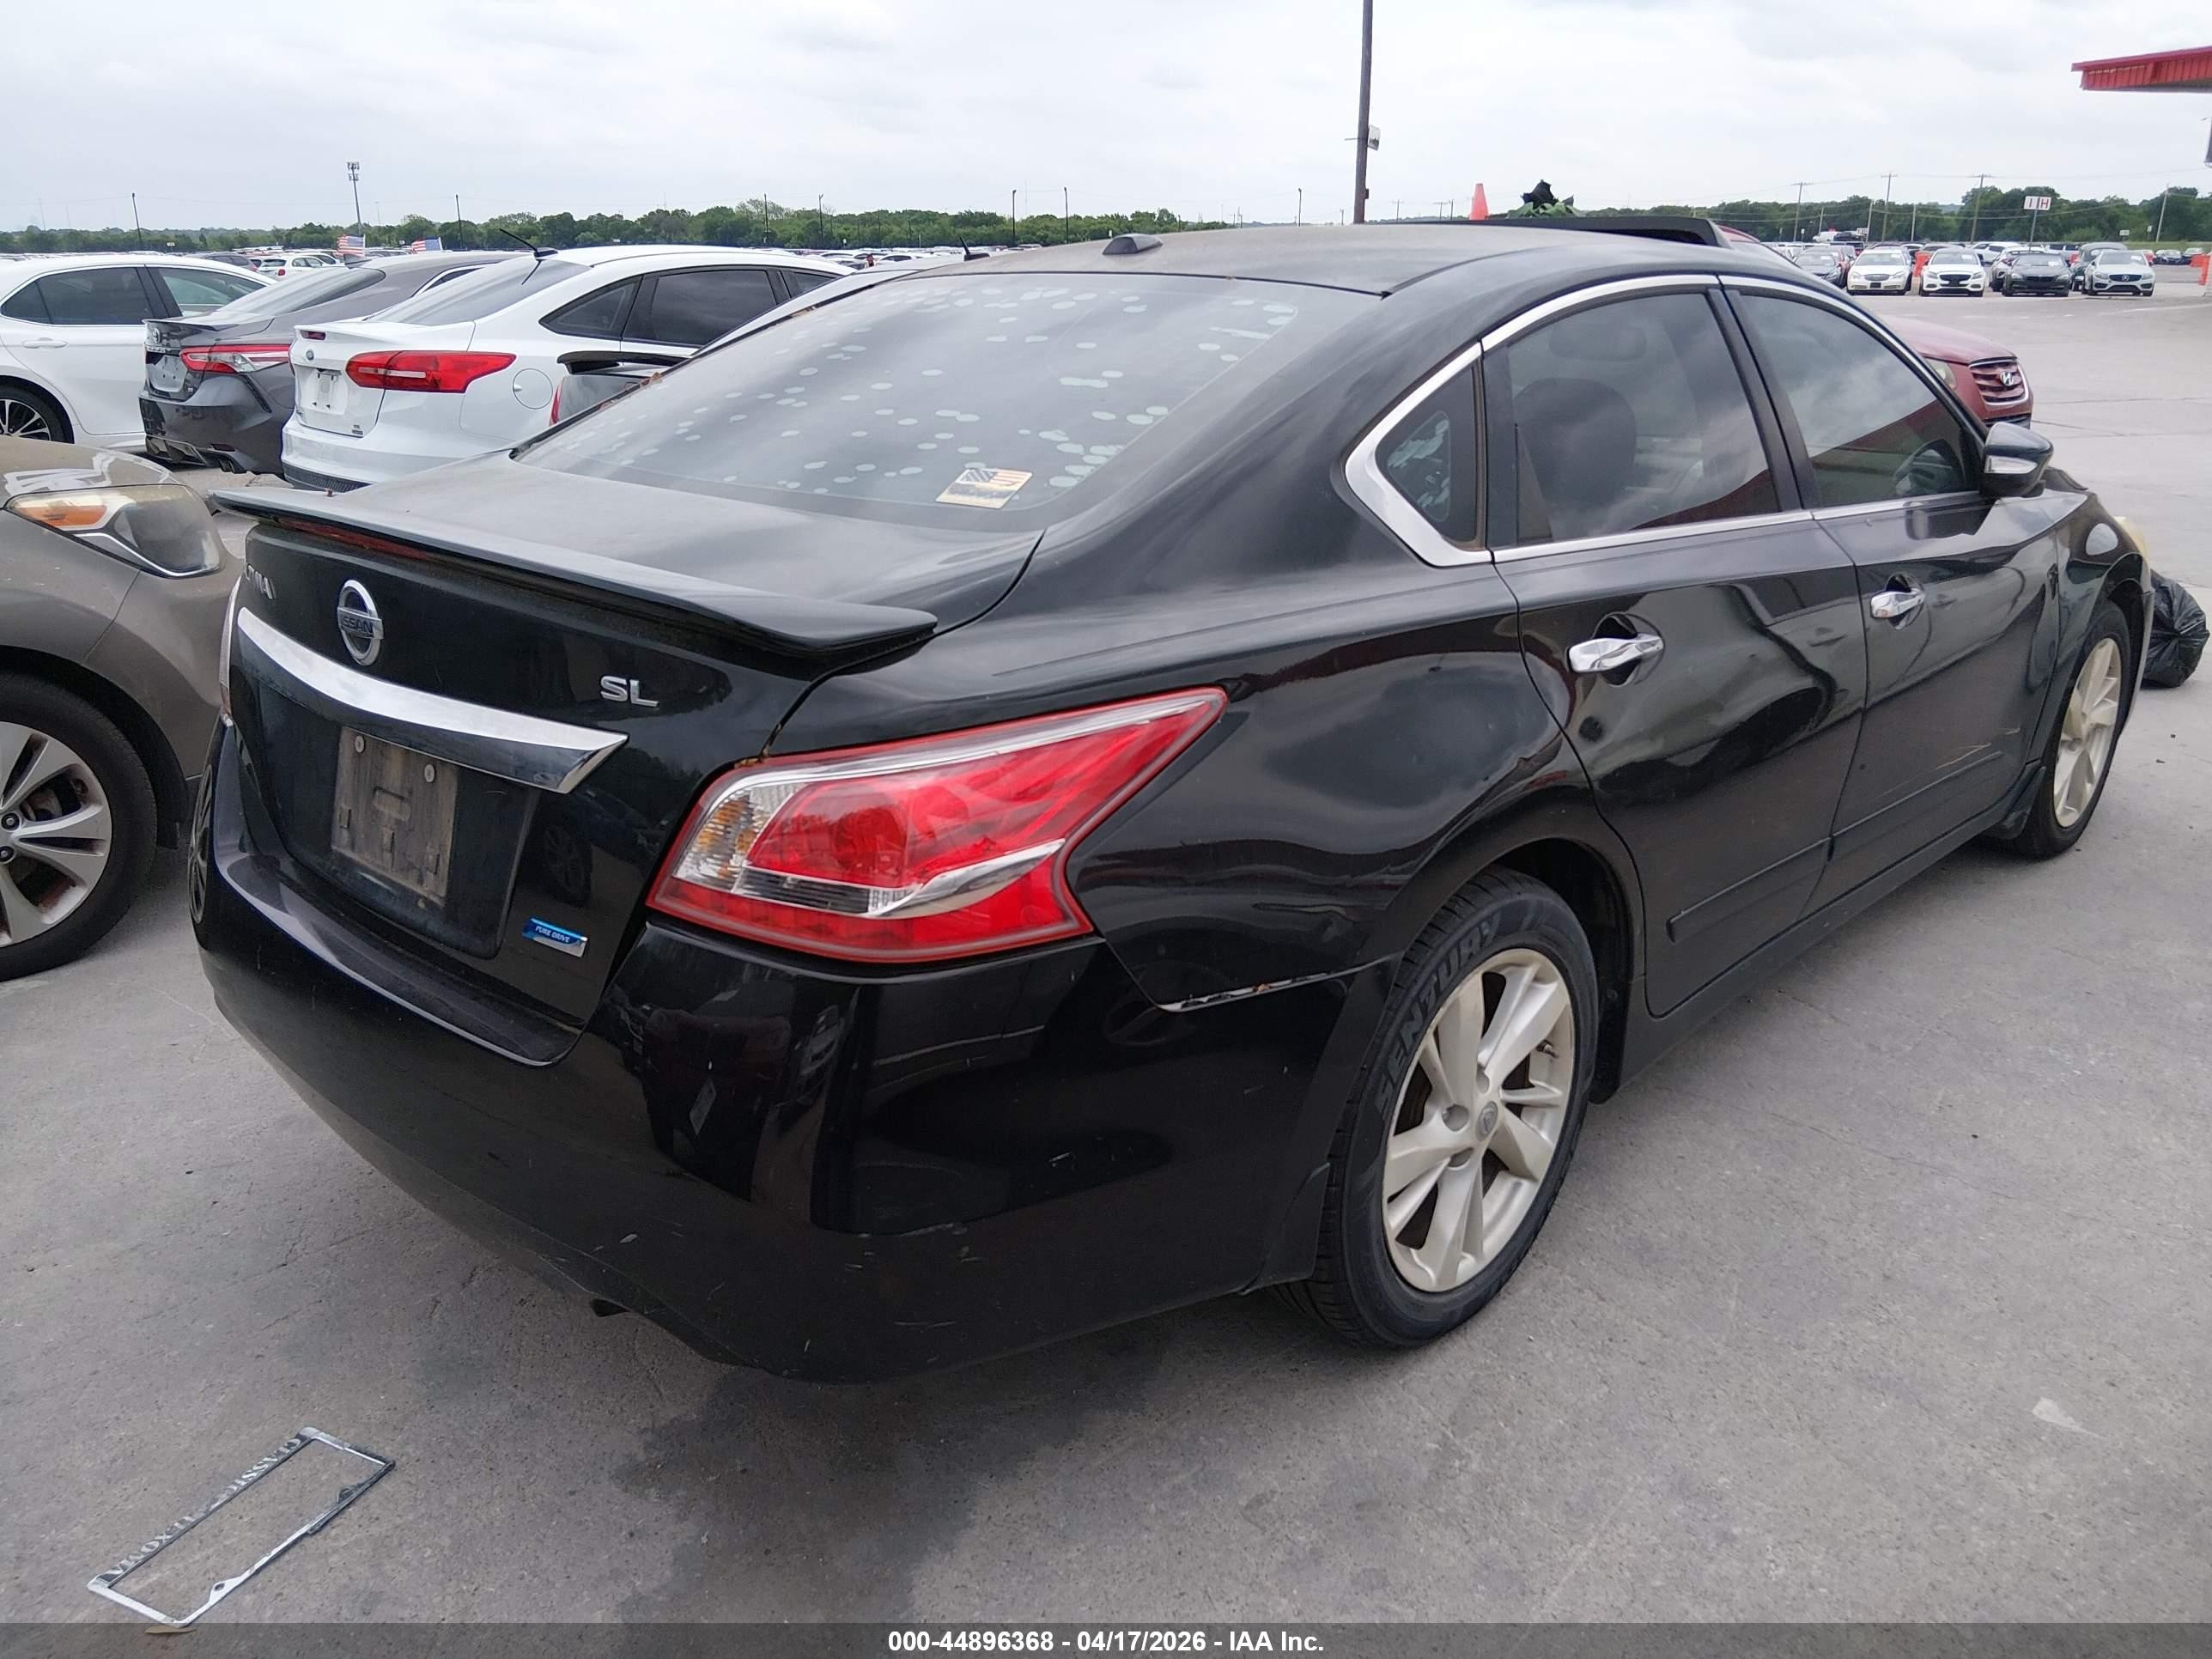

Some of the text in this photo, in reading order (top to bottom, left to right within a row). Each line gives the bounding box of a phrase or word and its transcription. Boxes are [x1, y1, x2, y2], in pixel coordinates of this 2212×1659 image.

[600, 675, 659, 708] SL
[535, 925, 571, 943] PURE DRIVE
